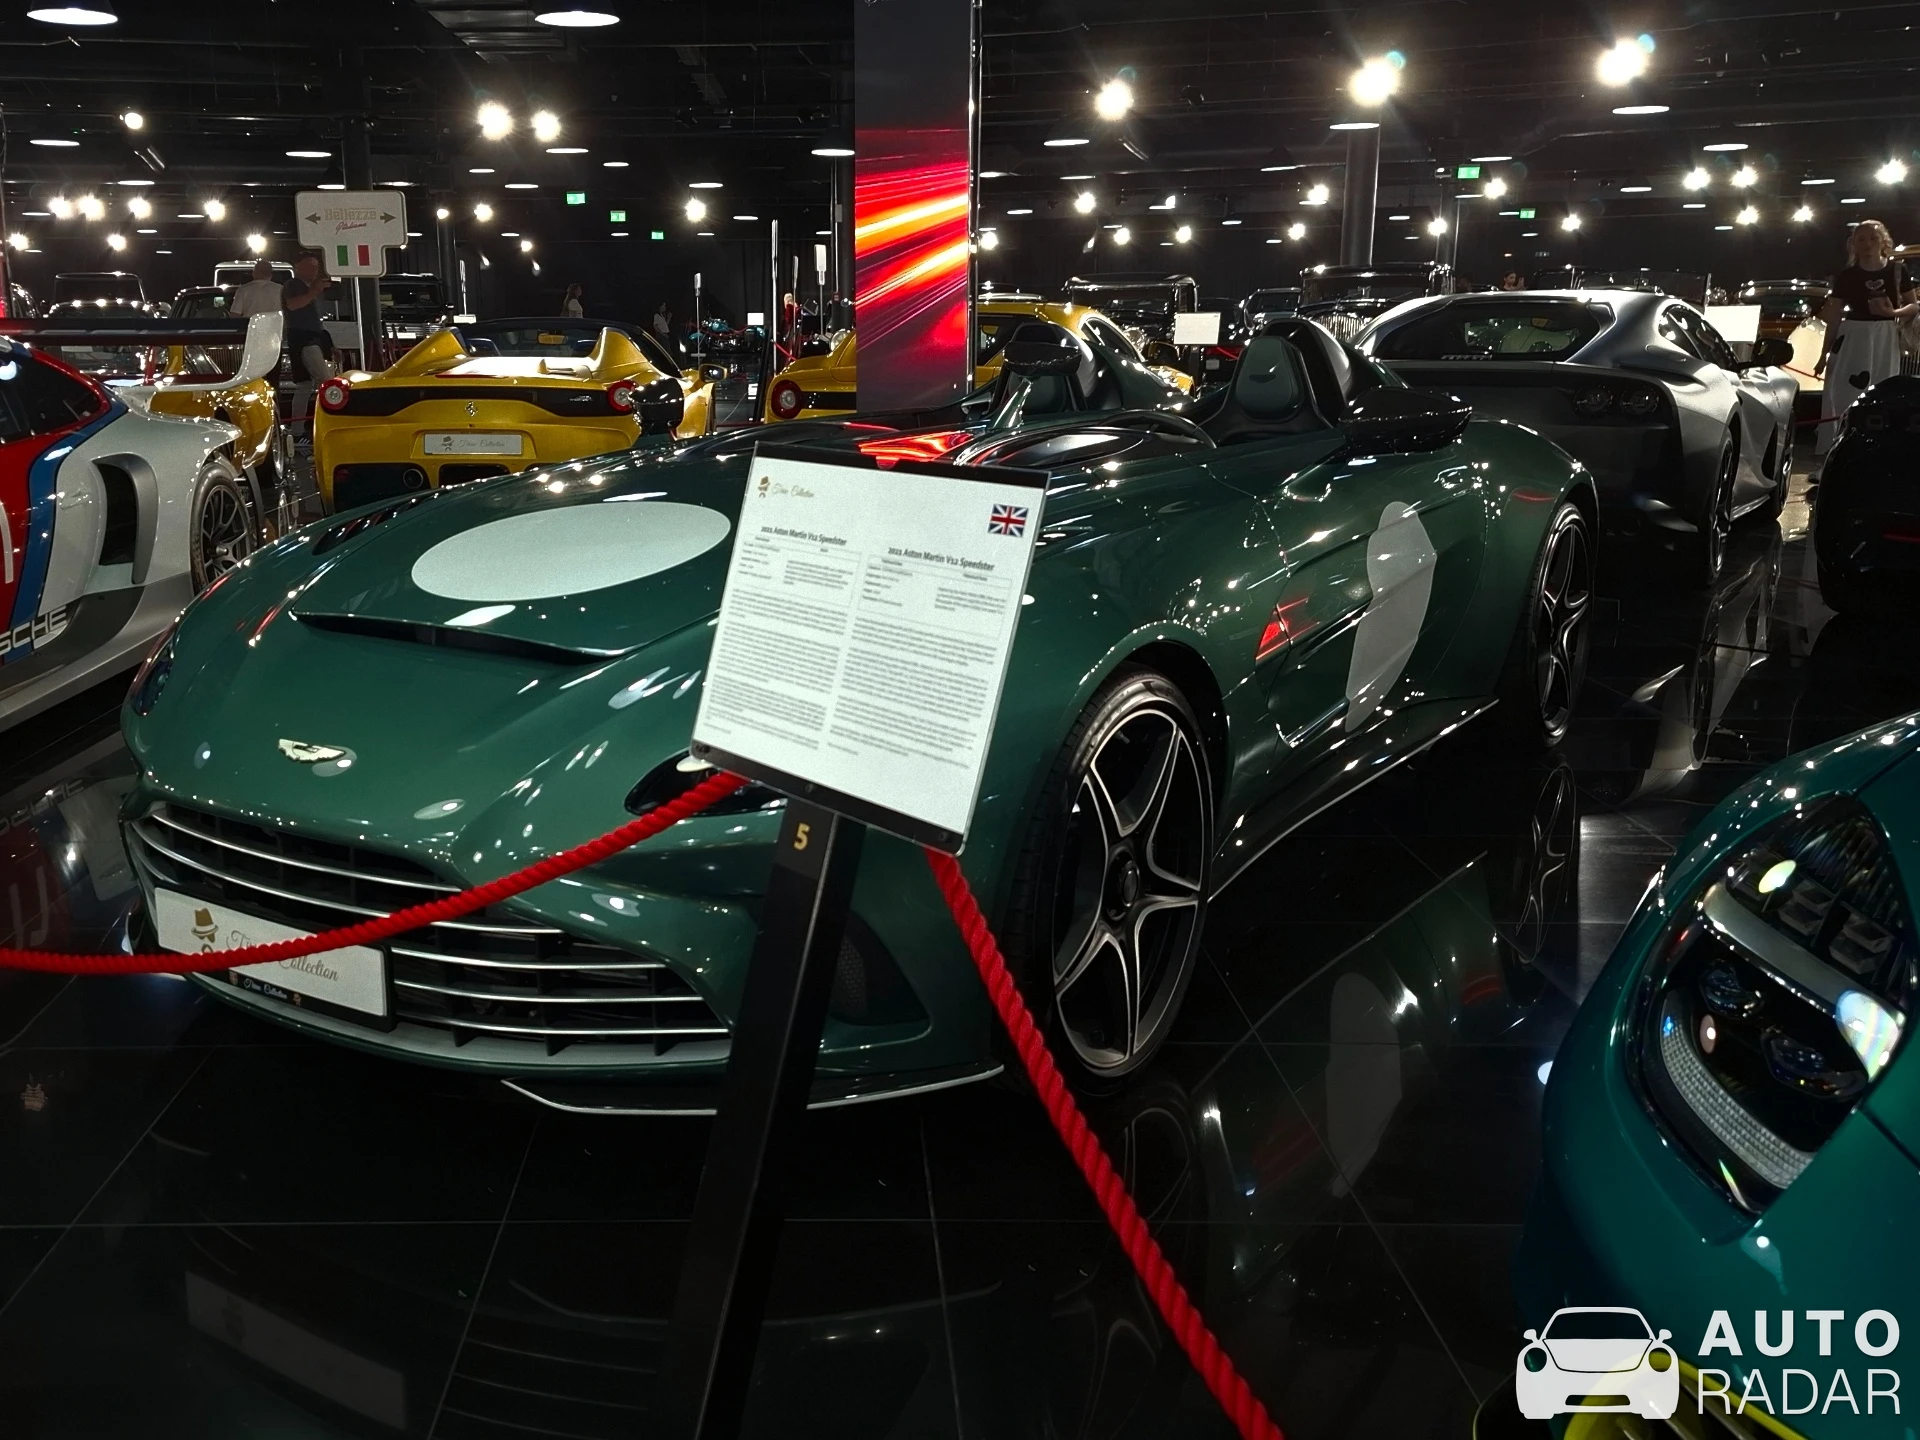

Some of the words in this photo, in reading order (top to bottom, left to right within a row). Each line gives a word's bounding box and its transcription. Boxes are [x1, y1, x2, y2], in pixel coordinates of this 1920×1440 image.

[325, 208, 376, 220] Bellezze
[774, 526, 789, 535] Aston
[789, 529, 807, 540] Martin
[818, 533, 847, 546] Speedster
[903, 548, 922, 559] Aston
[923, 551, 945, 563] Martin
[946, 555, 958, 565] V12
[959, 557, 995, 571] Speedster
[794, 823, 811, 851] 5
